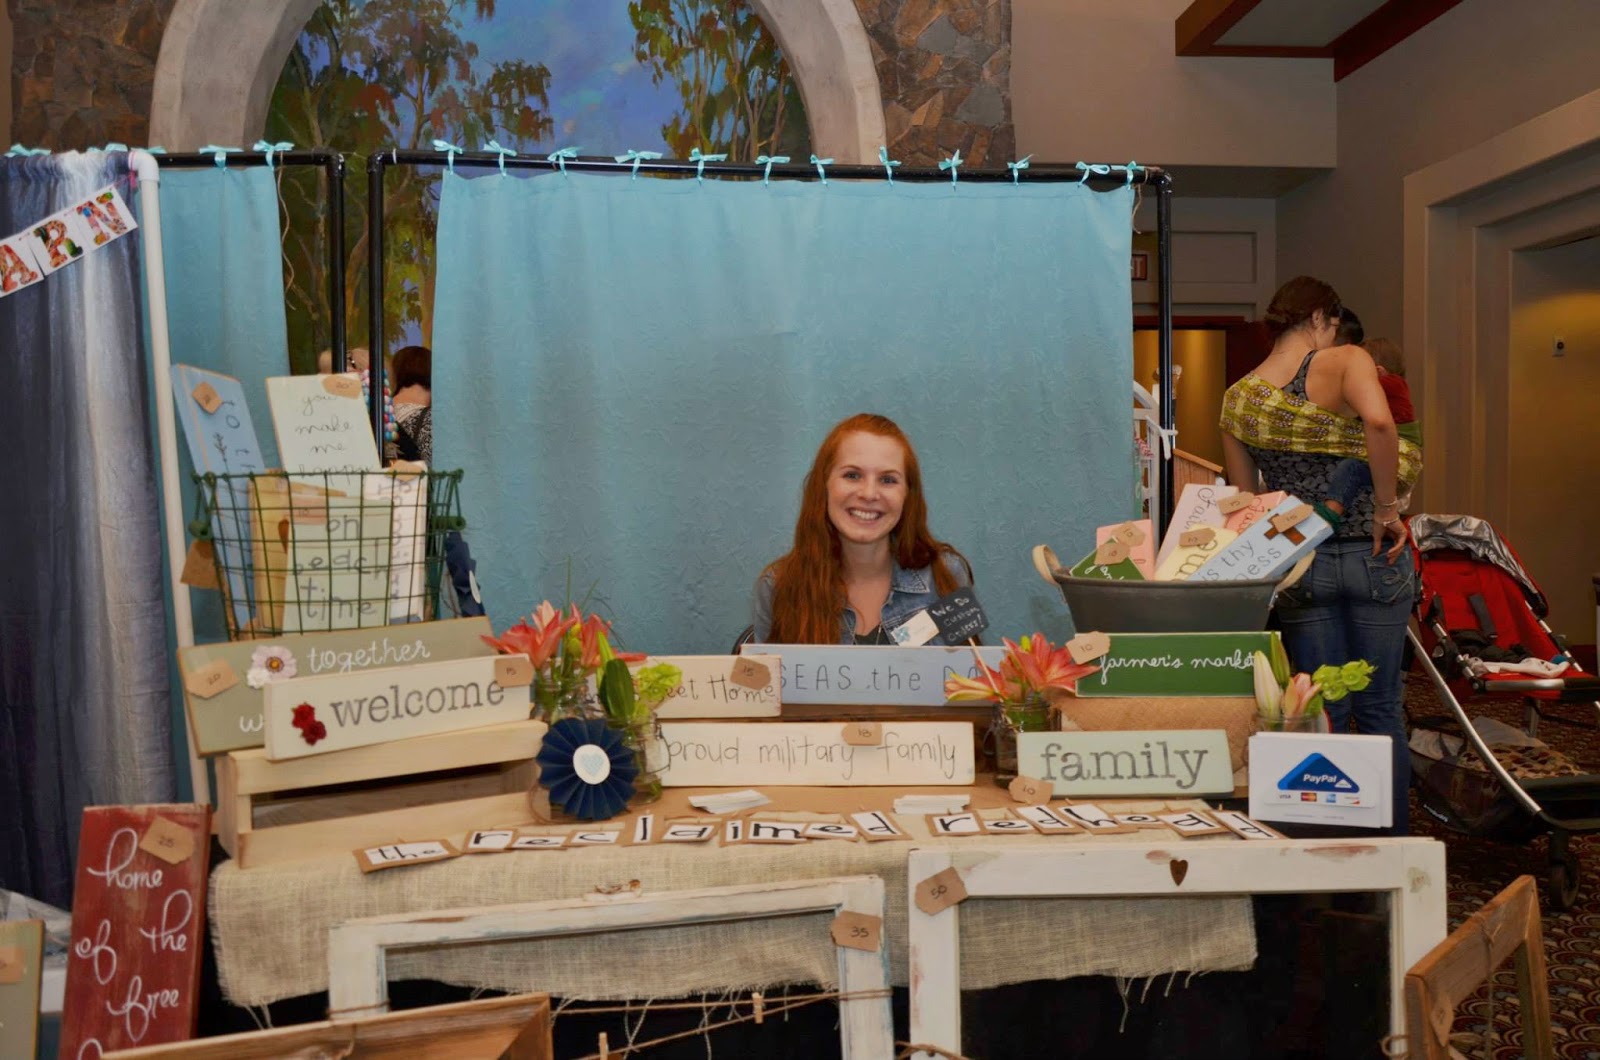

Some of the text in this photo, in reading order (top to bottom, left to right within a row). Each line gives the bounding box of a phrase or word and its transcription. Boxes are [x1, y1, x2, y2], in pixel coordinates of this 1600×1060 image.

[294, 416, 352, 435] make
[310, 442, 347, 455] me
[1220, 539, 1255, 568] thy
[299, 576, 377, 621] time
[931, 597, 970, 618] We Do
[306, 637, 431, 673] together
[1079, 642, 1094, 653] 10
[706, 672, 776, 704] Home
[871, 664, 922, 691] the
[329, 676, 506, 729] welcome
[667, 731, 956, 781] proud military family
[1040, 741, 1209, 790] family
[1020, 784, 1036, 796] 10
[1302, 773, 1338, 785] PayPal
[87, 828, 164, 890] home
[376, 843, 441, 862] the
[930, 884, 948, 898] 50
[75, 889, 193, 985] of the
[850, 925, 869, 938] 35
[106, 975, 180, 1042] free
